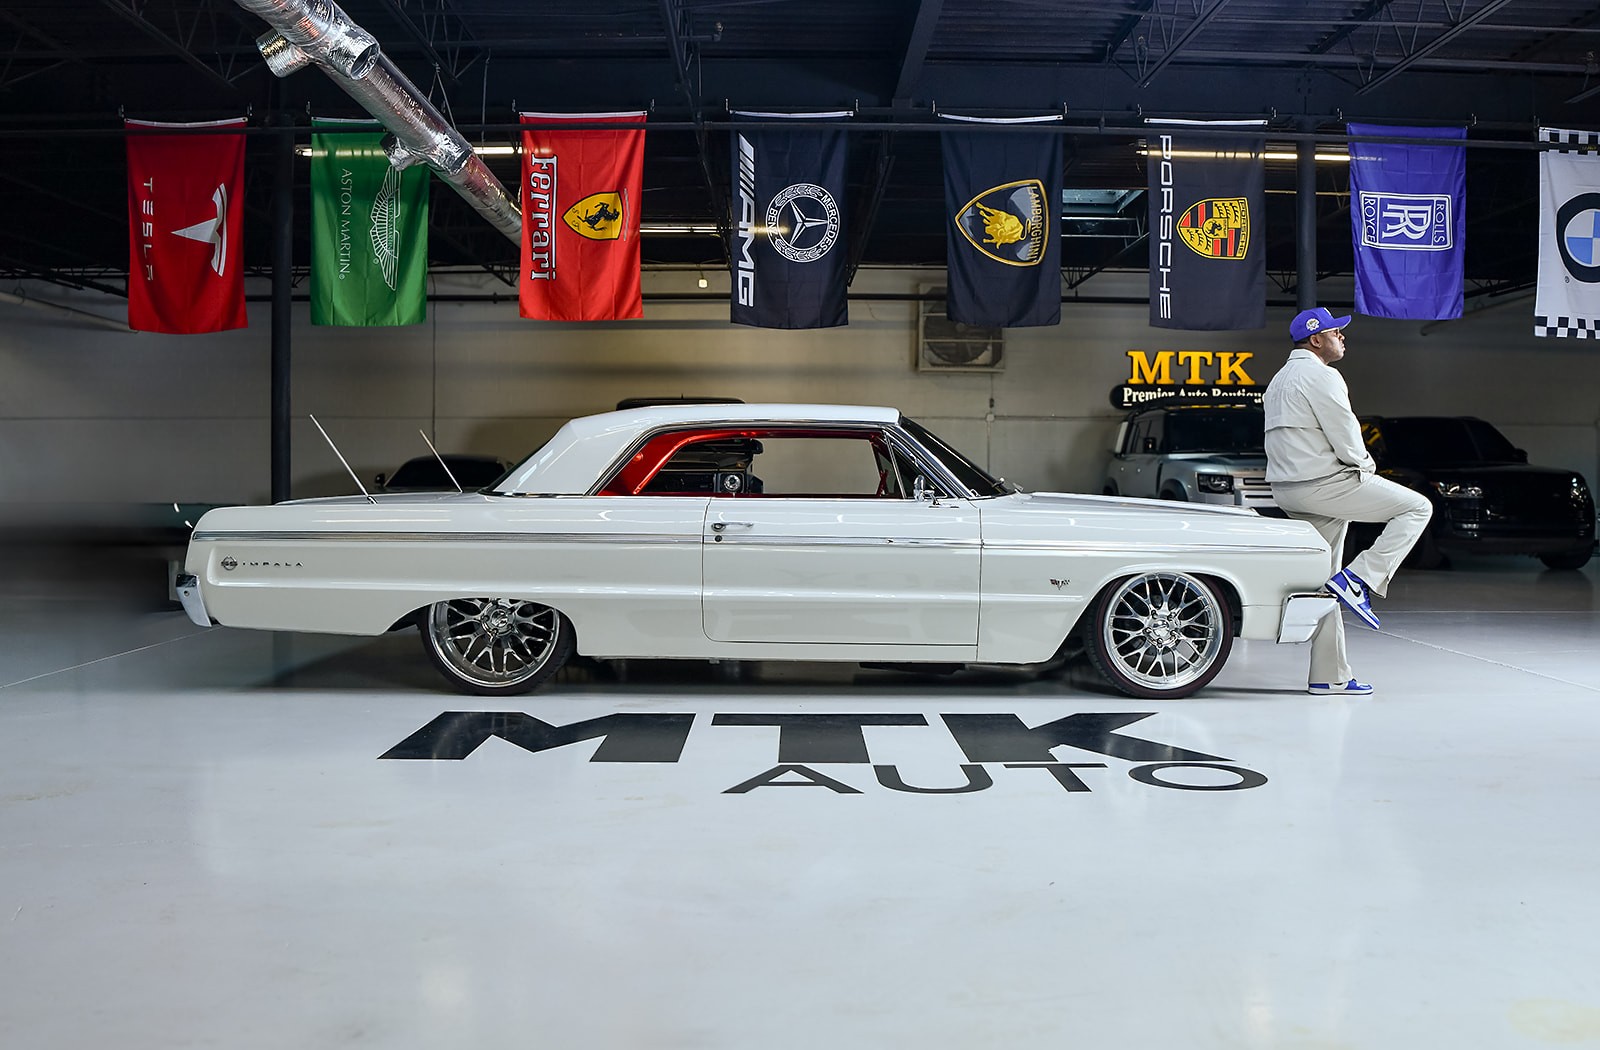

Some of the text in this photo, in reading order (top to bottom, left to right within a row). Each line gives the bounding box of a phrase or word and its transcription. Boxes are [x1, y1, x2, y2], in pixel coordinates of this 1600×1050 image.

[340, 168, 353, 216] ASTON
[143, 177, 155, 281] TESLA
[530, 153, 559, 281] Ferrari
[767, 208, 779, 240] BENZ
[820, 194, 838, 252] MERCEDES
[1025, 185, 1043, 263] LAMBORGHINI
[1159, 134, 1174, 320] PORSCHE
[1363, 197, 1377, 243] ROYCE
[1433, 202, 1446, 244] ROLLS
[1126, 350, 1256, 385] MTK
[1122, 387, 1175, 403] Premier
[376, 711, 1236, 763] MTK
[720, 762, 1268, 794] AUTO
